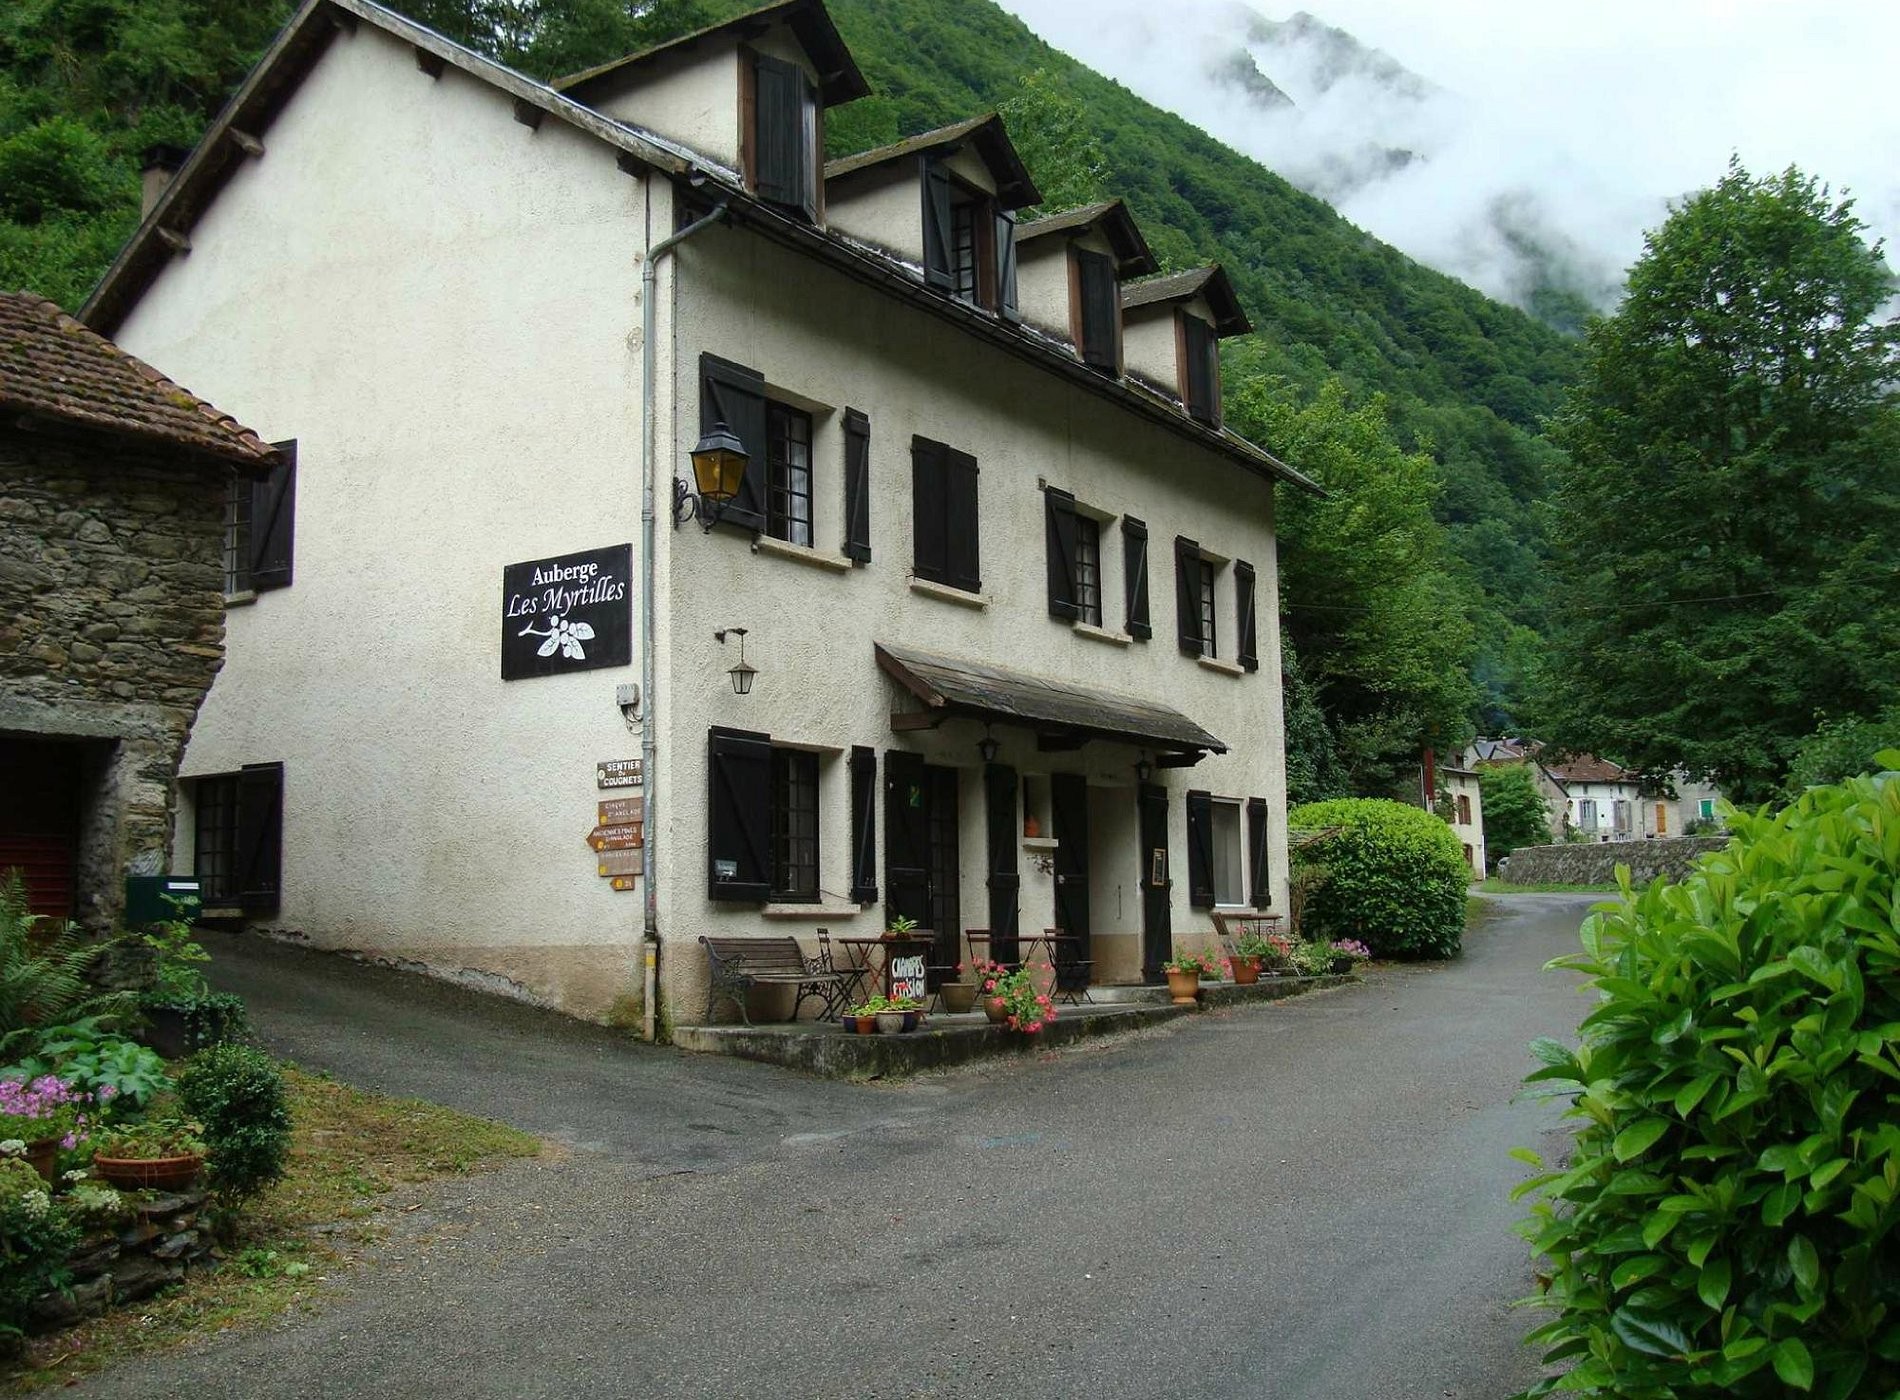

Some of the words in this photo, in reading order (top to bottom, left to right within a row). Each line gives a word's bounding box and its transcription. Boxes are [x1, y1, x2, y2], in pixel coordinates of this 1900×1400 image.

[532, 562, 598, 586] Auberge
[507, 594, 538, 617] Les
[542, 575, 625, 617] Myrtilles
[607, 761, 641, 772] SENTIER
